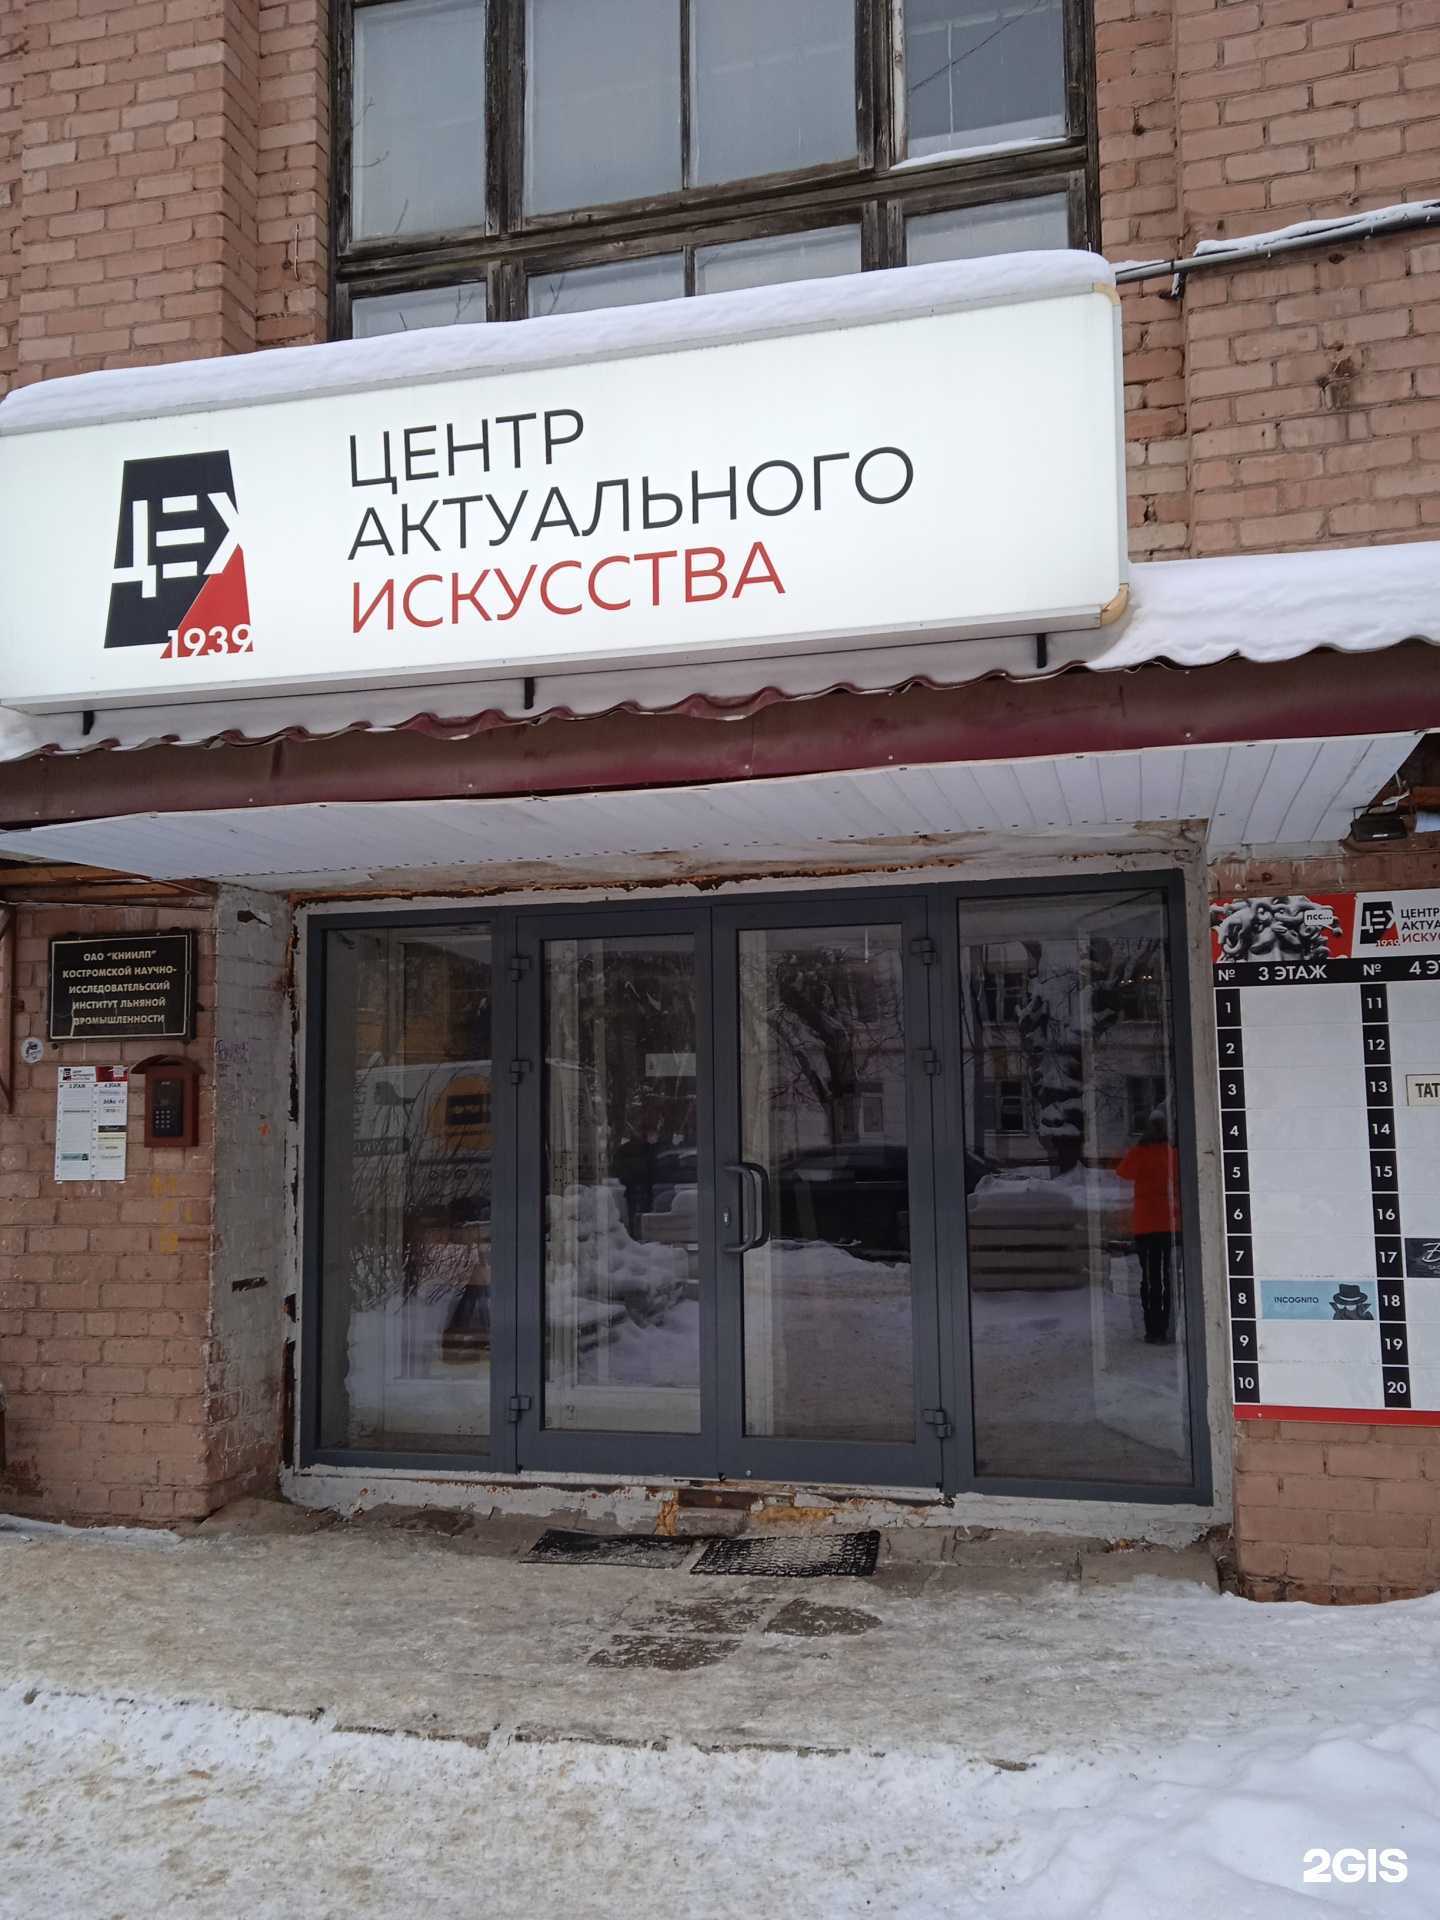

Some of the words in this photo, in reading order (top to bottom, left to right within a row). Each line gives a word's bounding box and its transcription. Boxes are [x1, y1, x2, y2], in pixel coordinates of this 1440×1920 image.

[348, 409, 585, 494] ЦЕНТР
[347, 446, 914, 561] АКТУАЛЬНОГО
[353, 541, 787, 634] ИСКУССТВА
[167, 624, 253, 658] 1939
[1401, 907, 1440, 920] ЦЕНТР
[83, 953, 105, 961] ОАО
[62, 966, 133, 978] КОСТРОМСКОЙ
[134, 965, 177, 976] НАУЧНО-
[1218, 969, 1236, 981] №
[1258, 967, 1270, 981] 3
[1273, 964, 1327, 980] ЭТАЖ
[1362, 963, 1383, 976] №
[1409, 961, 1422, 975] 4
[68, 980, 171, 994] ИССЛЕДОВАТЕЛЬСКИЙ
[72, 1000, 118, 1010] ИНСТИТУТ
[119, 997, 166, 1008] ЛЬНЯНОЙ
[1224, 1002, 1231, 1013] 1
[1366, 997, 1382, 1009] 11
[72, 1014, 166, 1026] ПРОМЫШЛЕННОСТИ
[1226, 1043, 1235, 1054] 2
[1367, 1039, 1386, 1051] 12
[1227, 1084, 1237, 1096] 3
[1370, 1081, 1388, 1093] 13
[1229, 1125, 1239, 1137] 4
[1372, 1123, 1390, 1135] 14
[1232, 1167, 1241, 1178] 5
[1375, 1165, 1393, 1178] 15
[1233, 1209, 1243, 1220] 6
[1377, 1208, 1396, 1221] 16
[1235, 1251, 1244, 1262] 7
[1379, 1252, 1397, 1264] 17
[1238, 1293, 1248, 1304] 8
[1274, 1296, 1319, 1304] INCOGNITO
[1382, 1295, 1400, 1307] 18
[1239, 1335, 1249, 1347] 9
[1384, 1338, 1403, 1351] 19
[1238, 1378, 1254, 1390] 10
[1387, 1381, 1407, 1394] 20
